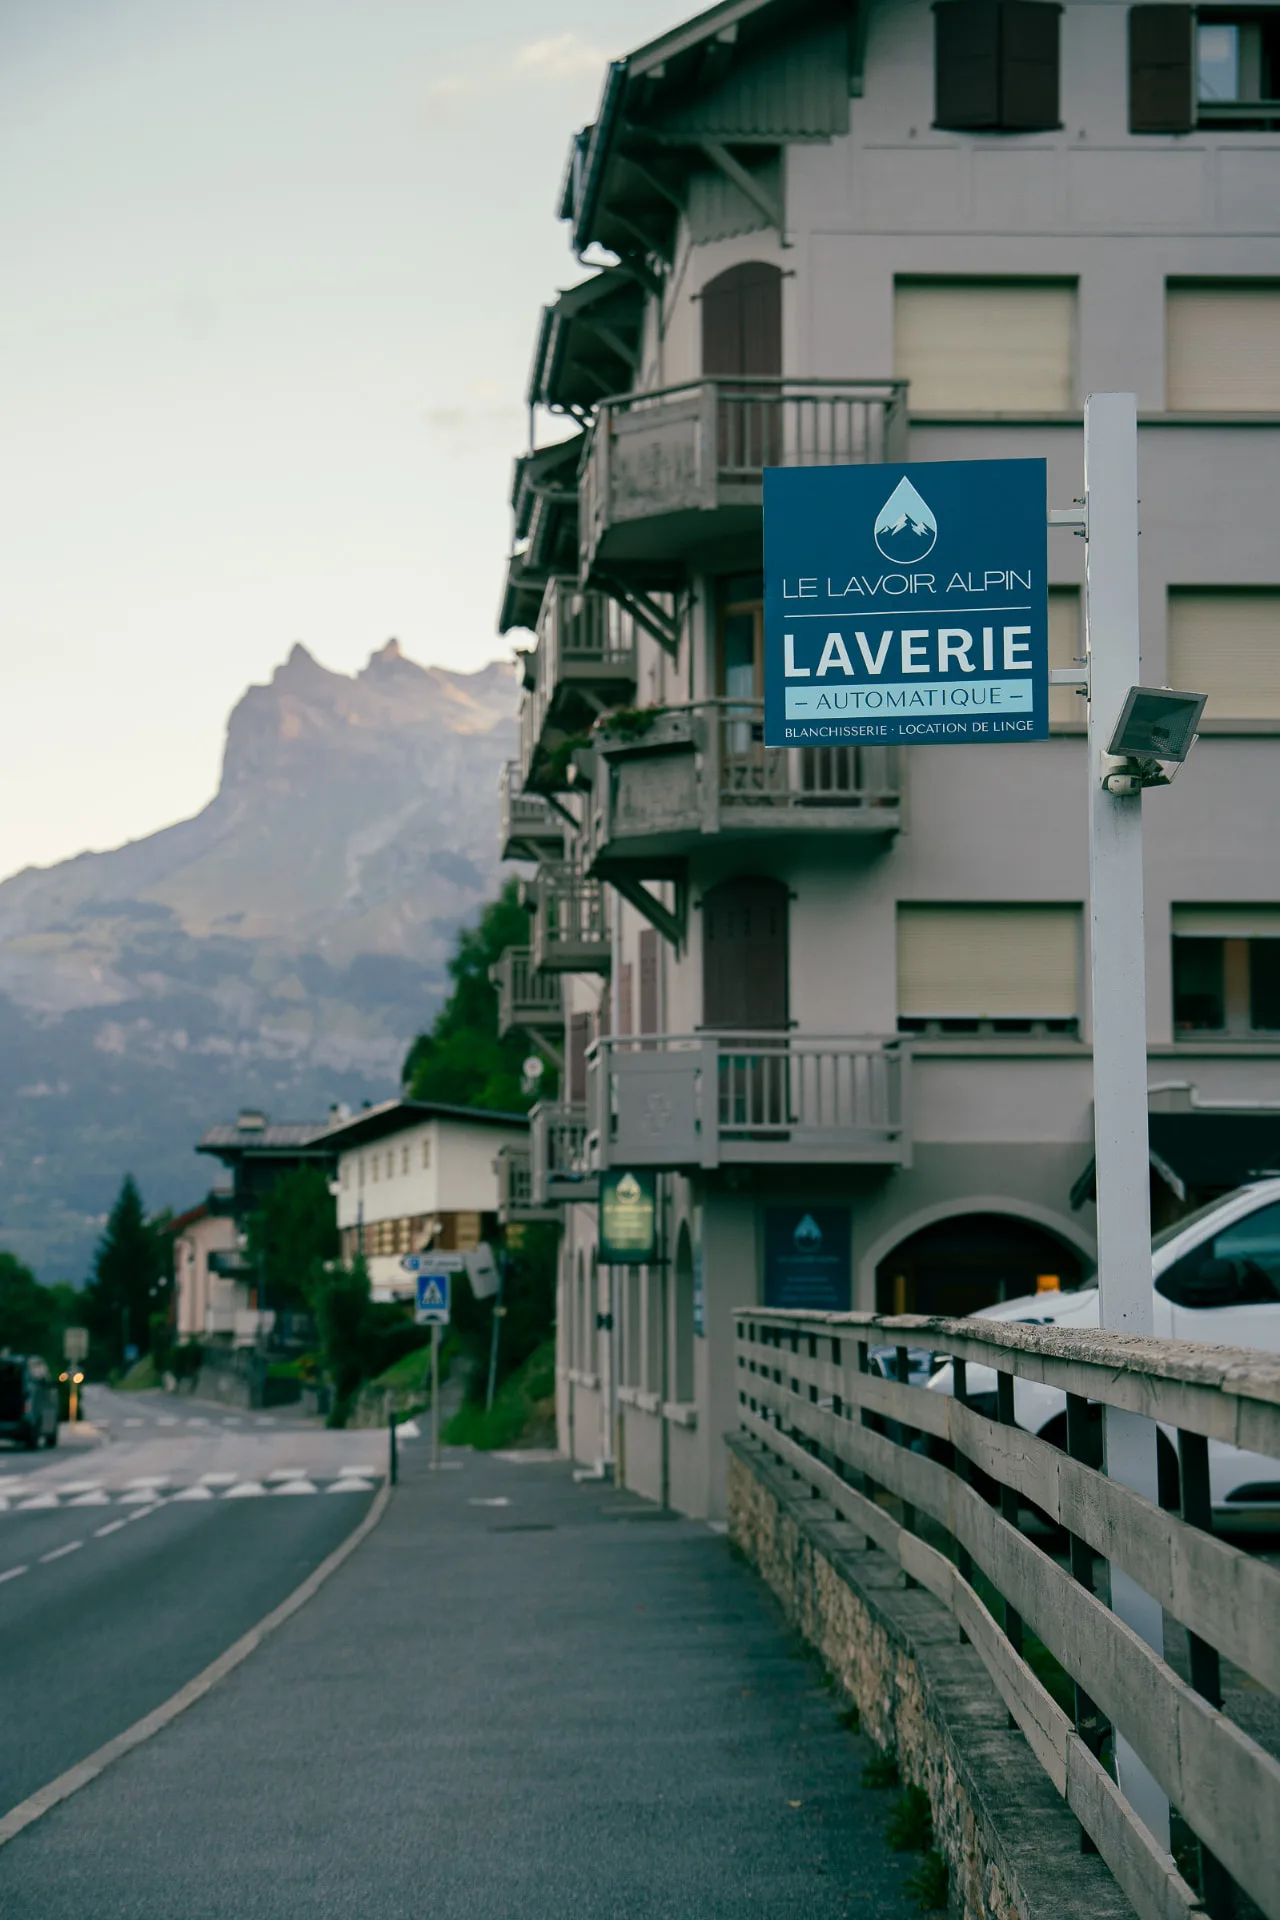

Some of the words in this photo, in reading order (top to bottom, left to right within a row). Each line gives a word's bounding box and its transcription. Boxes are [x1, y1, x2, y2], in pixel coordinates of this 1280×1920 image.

[783, 578, 818, 599] LE
[827, 573, 937, 597] LAVOIR
[945, 569, 1032, 593] ALPIN
[783, 625, 1033, 678] LAVERIE
[815, 687, 1003, 710] AUTOMATIQUE
[785, 725, 888, 739] BLANCHISSERIE
[898, 722, 969, 735] LOCATION
[972, 721, 989, 733] DE
[992, 720, 1034, 732] LINGE
